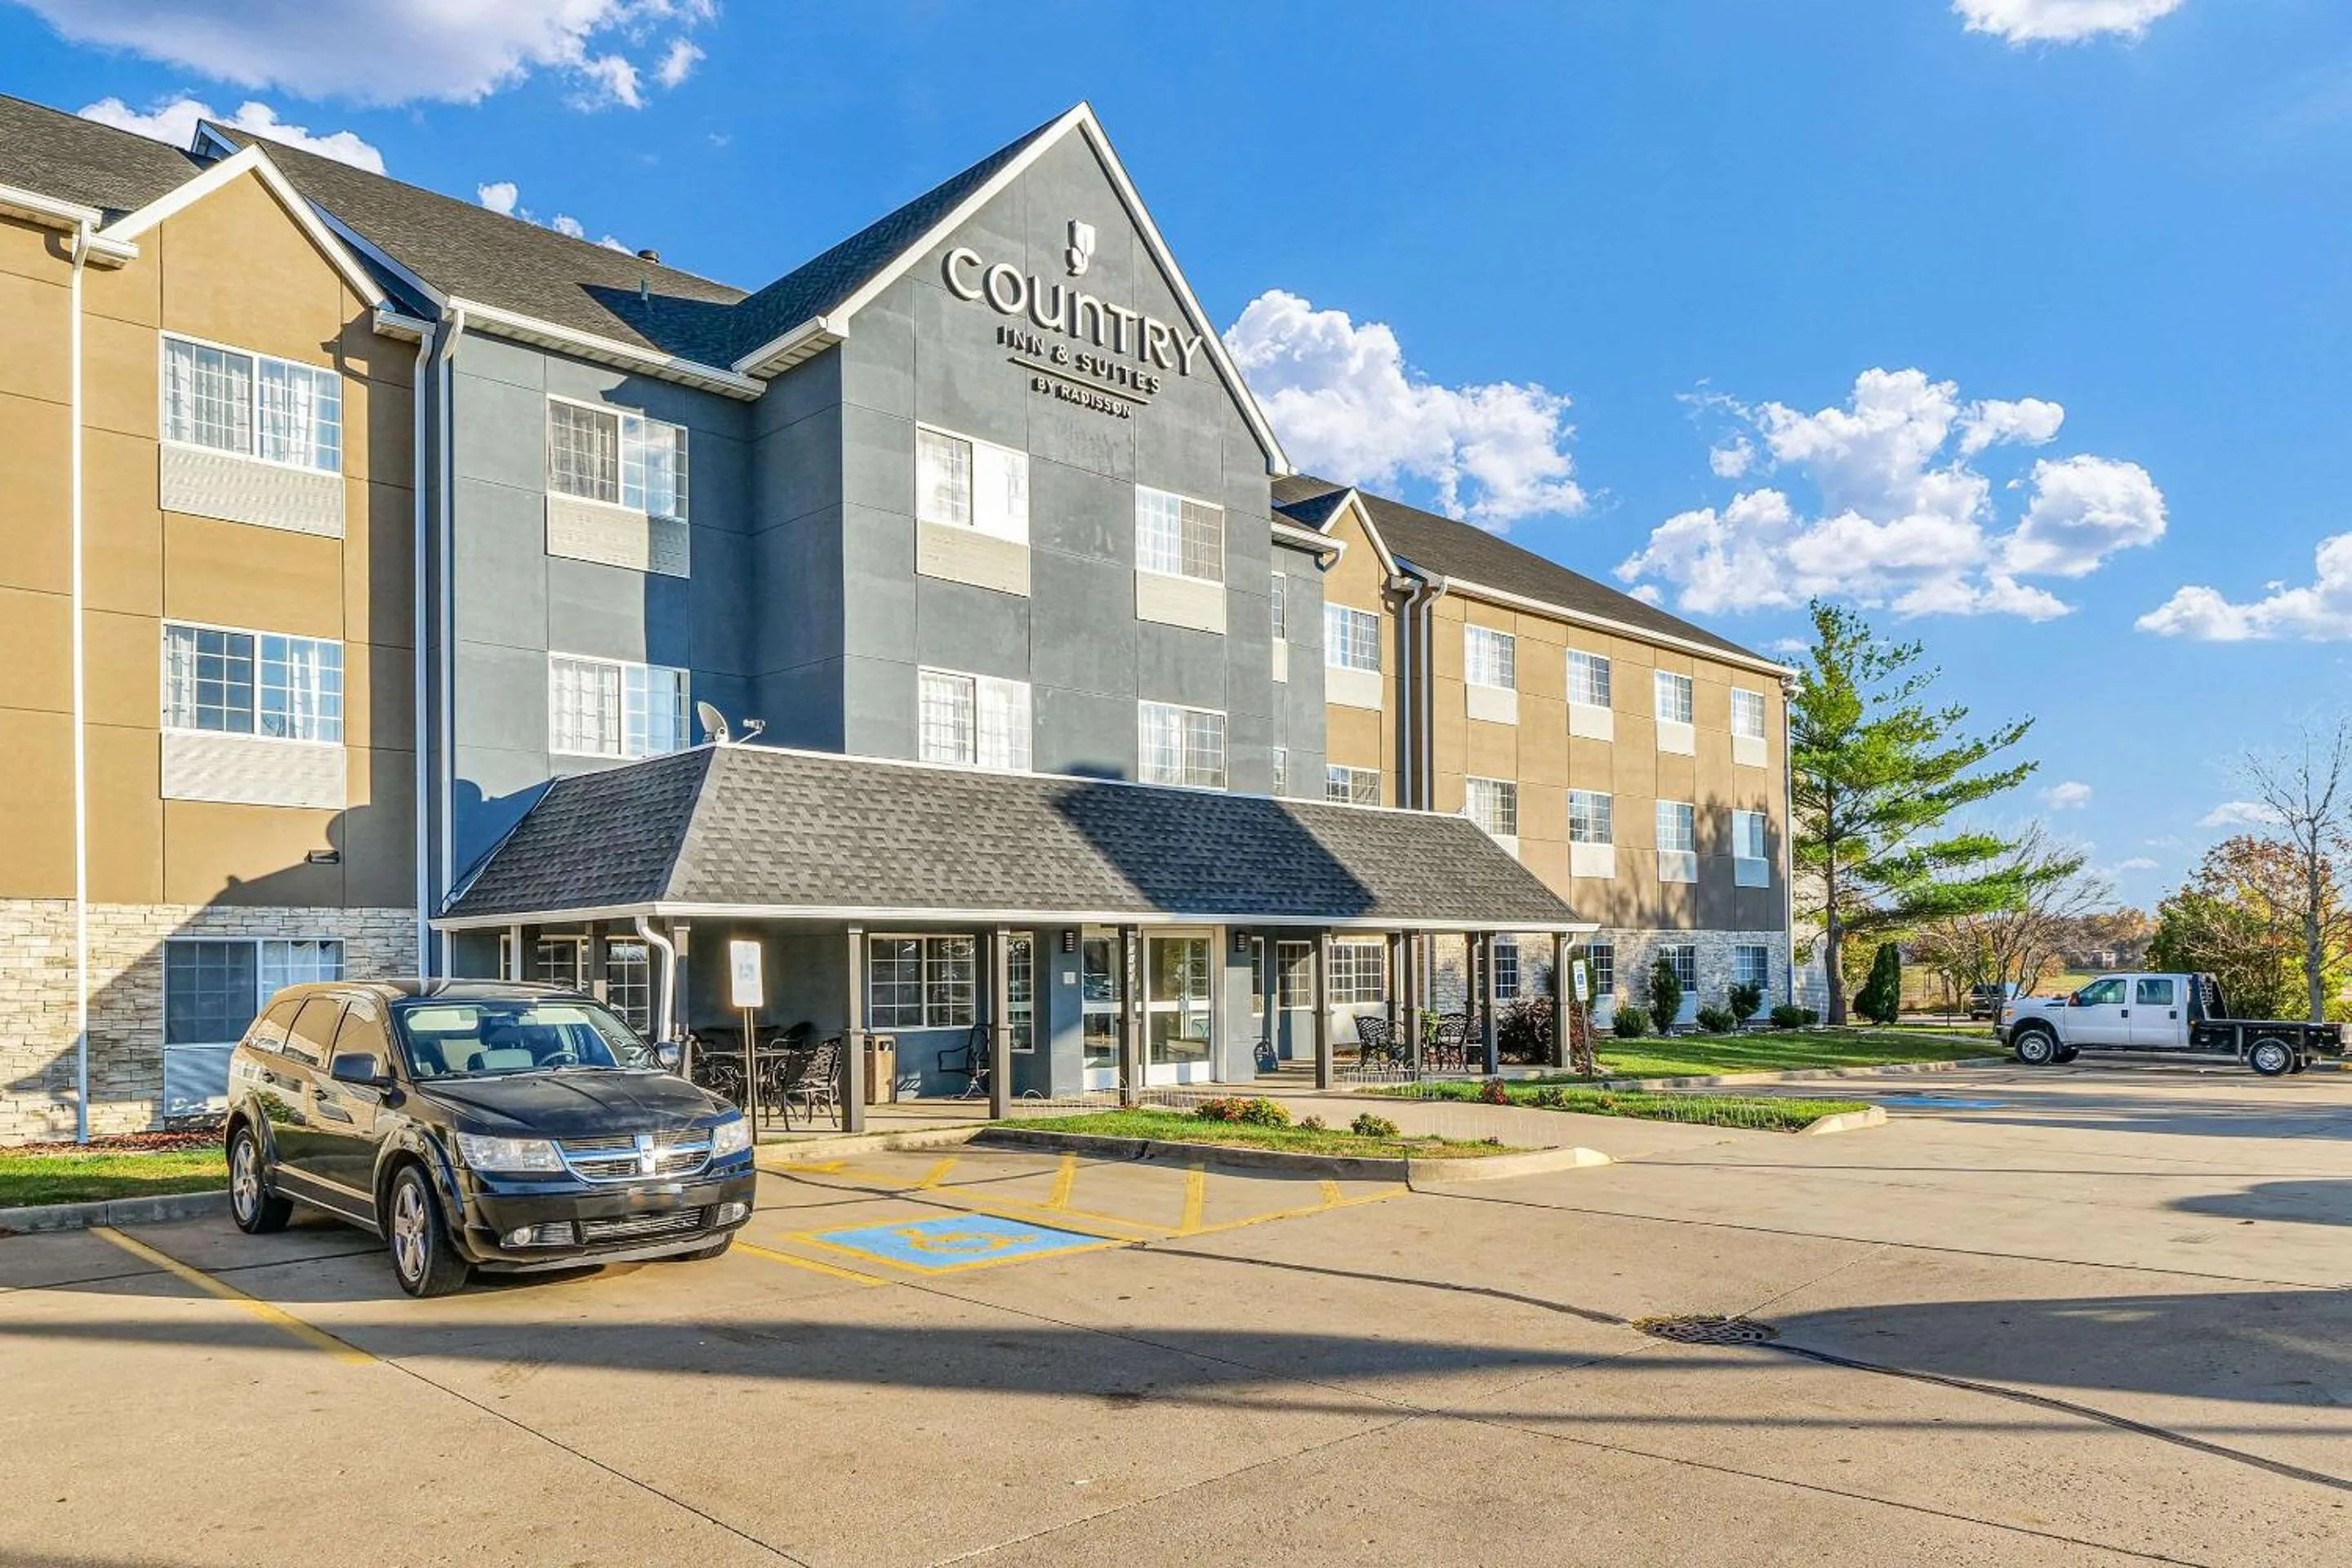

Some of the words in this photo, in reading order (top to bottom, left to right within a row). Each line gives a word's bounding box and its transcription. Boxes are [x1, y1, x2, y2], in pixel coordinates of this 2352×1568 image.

[997, 324, 1045, 355] INN
[1052, 344, 1070, 364] &
[1076, 352, 1161, 394] SUITES
[1032, 377, 1055, 394] BY
[1056, 385, 1132, 419] RADISSON
